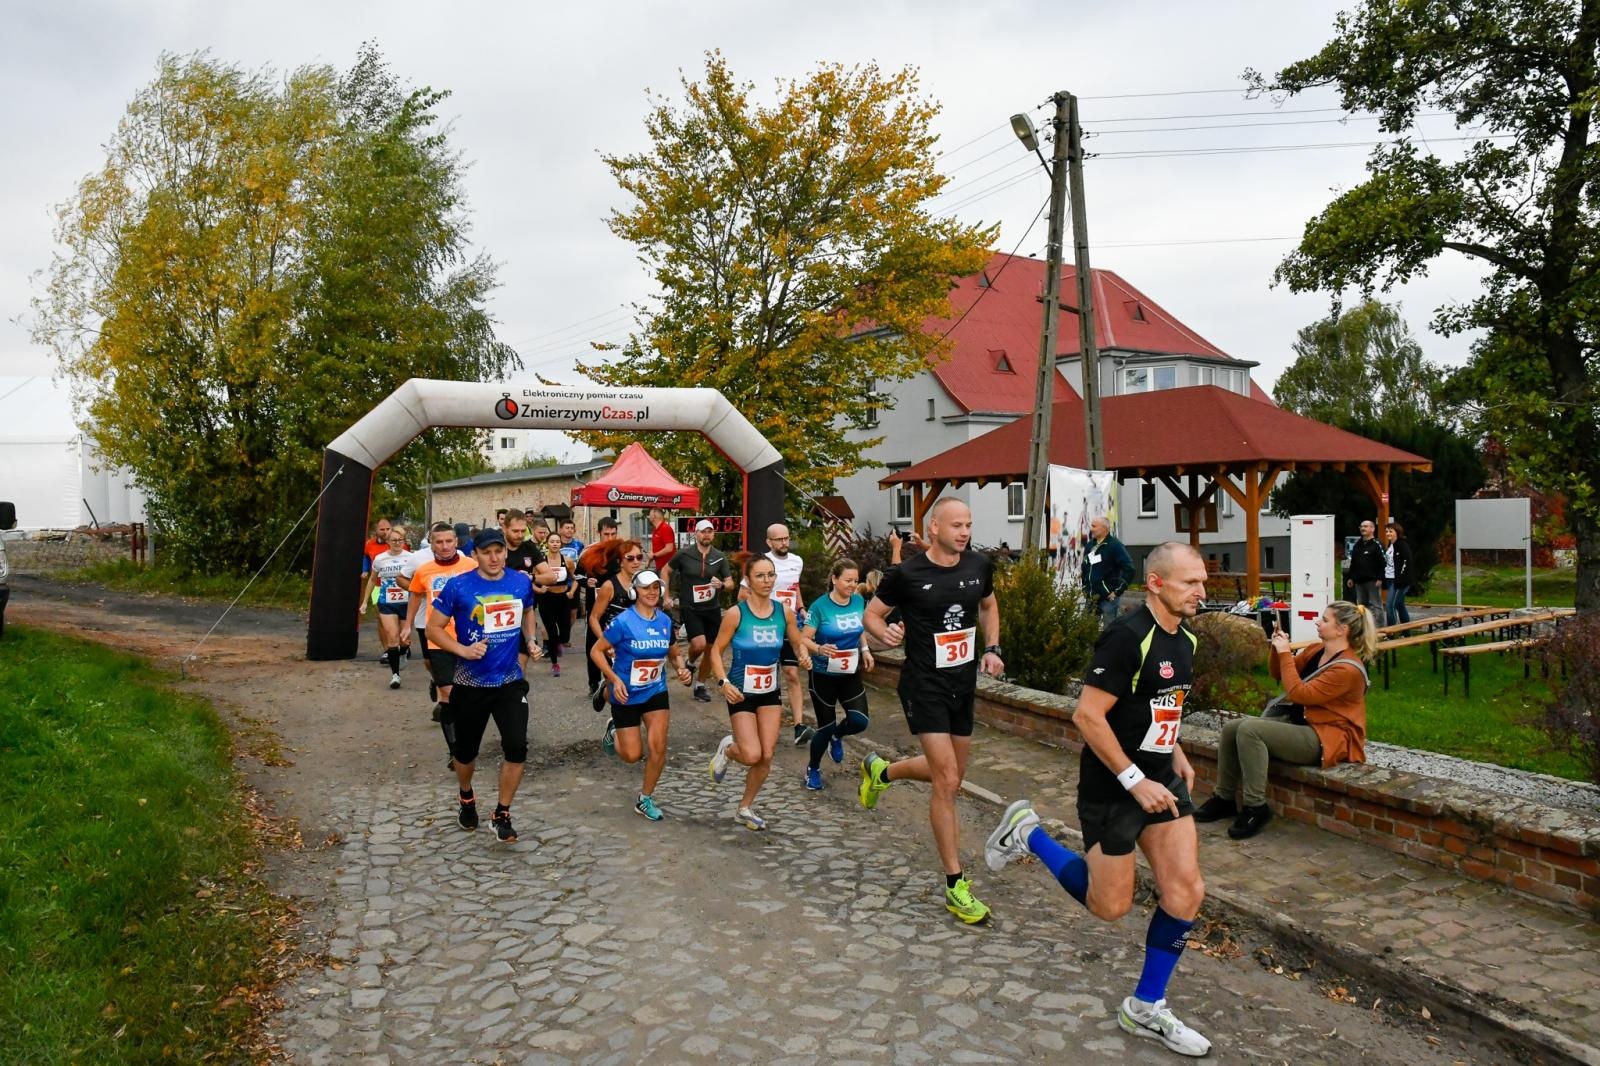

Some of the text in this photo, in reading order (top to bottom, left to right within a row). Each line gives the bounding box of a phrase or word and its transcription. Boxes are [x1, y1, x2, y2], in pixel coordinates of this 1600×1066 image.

[522, 389, 584, 400] Elektroniczny
[586, 392, 617, 400] pomiar
[521, 404, 649, 422] ZmierzymyCzas.pl
[390, 592, 404, 601] 22
[697, 590, 712, 600] 24
[493, 610, 516, 628] 12
[946, 641, 968, 662] 30
[840, 658, 850, 671] 3
[638, 667, 660, 682] 20
[752, 674, 773, 690] 19
[1155, 724, 1177, 745] 21
